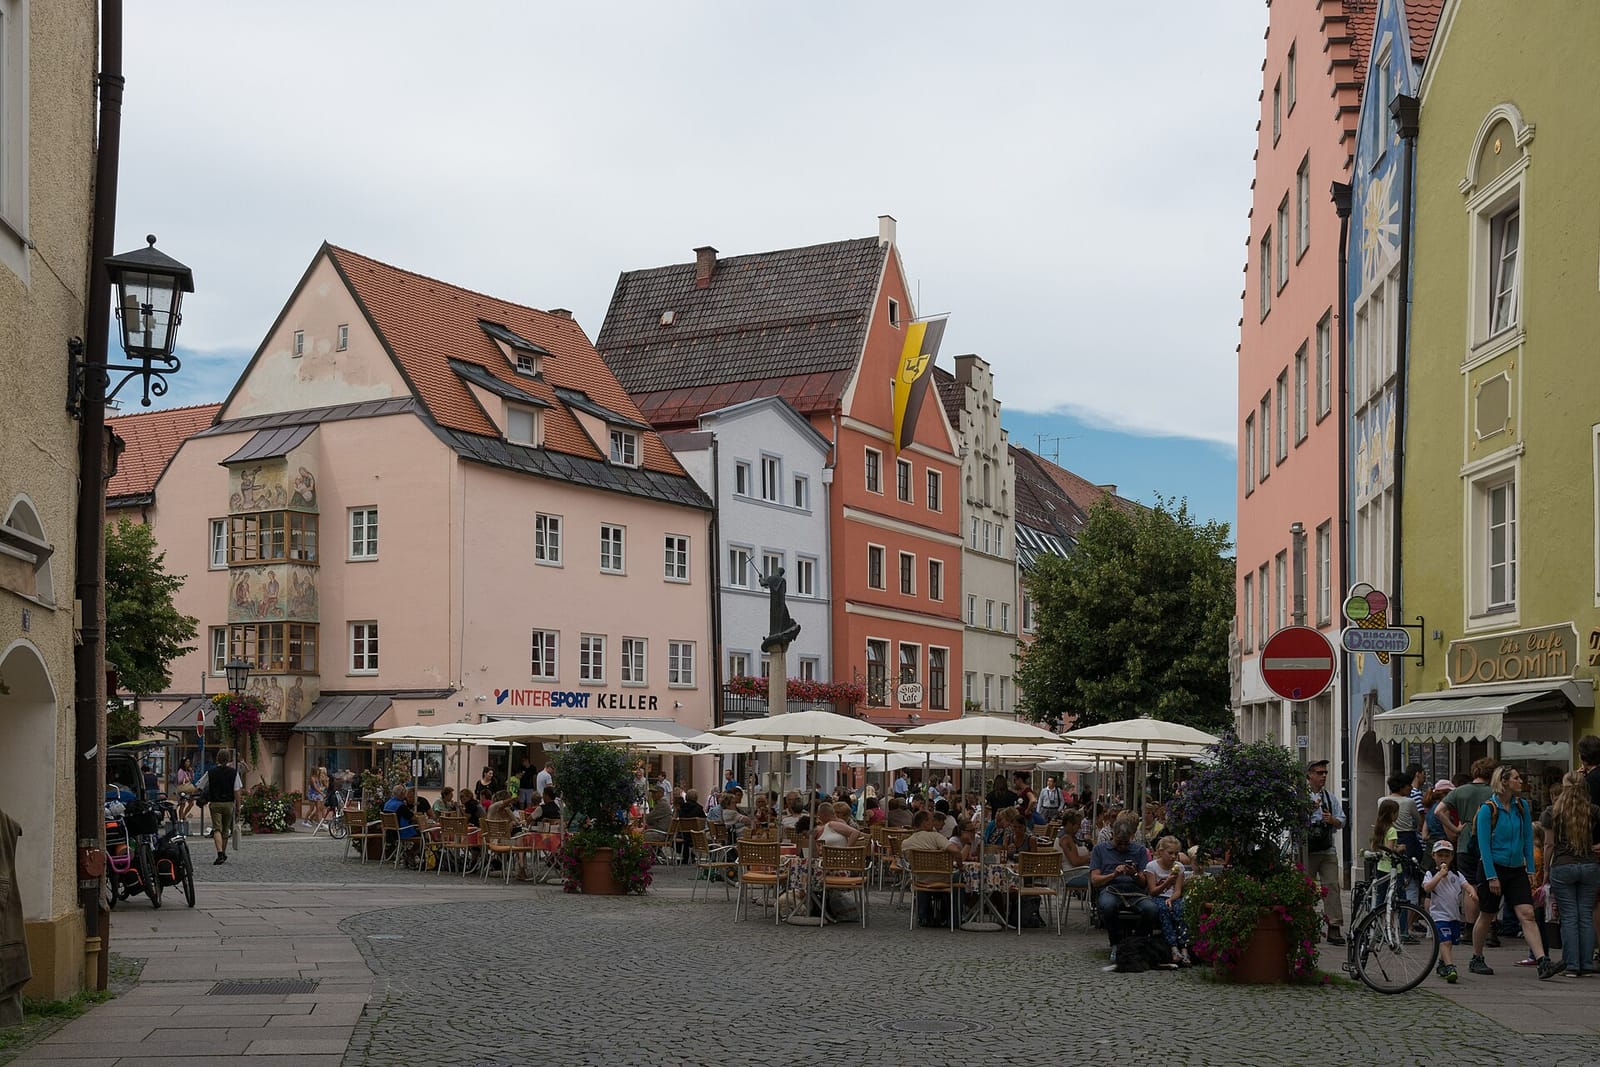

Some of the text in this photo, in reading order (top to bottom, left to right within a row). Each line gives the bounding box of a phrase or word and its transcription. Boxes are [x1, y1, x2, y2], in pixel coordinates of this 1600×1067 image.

[1349, 631, 1405, 650] DOLOMITI
[1455, 643, 1567, 683] DOLOMITI
[511, 689, 658, 711] INTERSPORT KELLER
